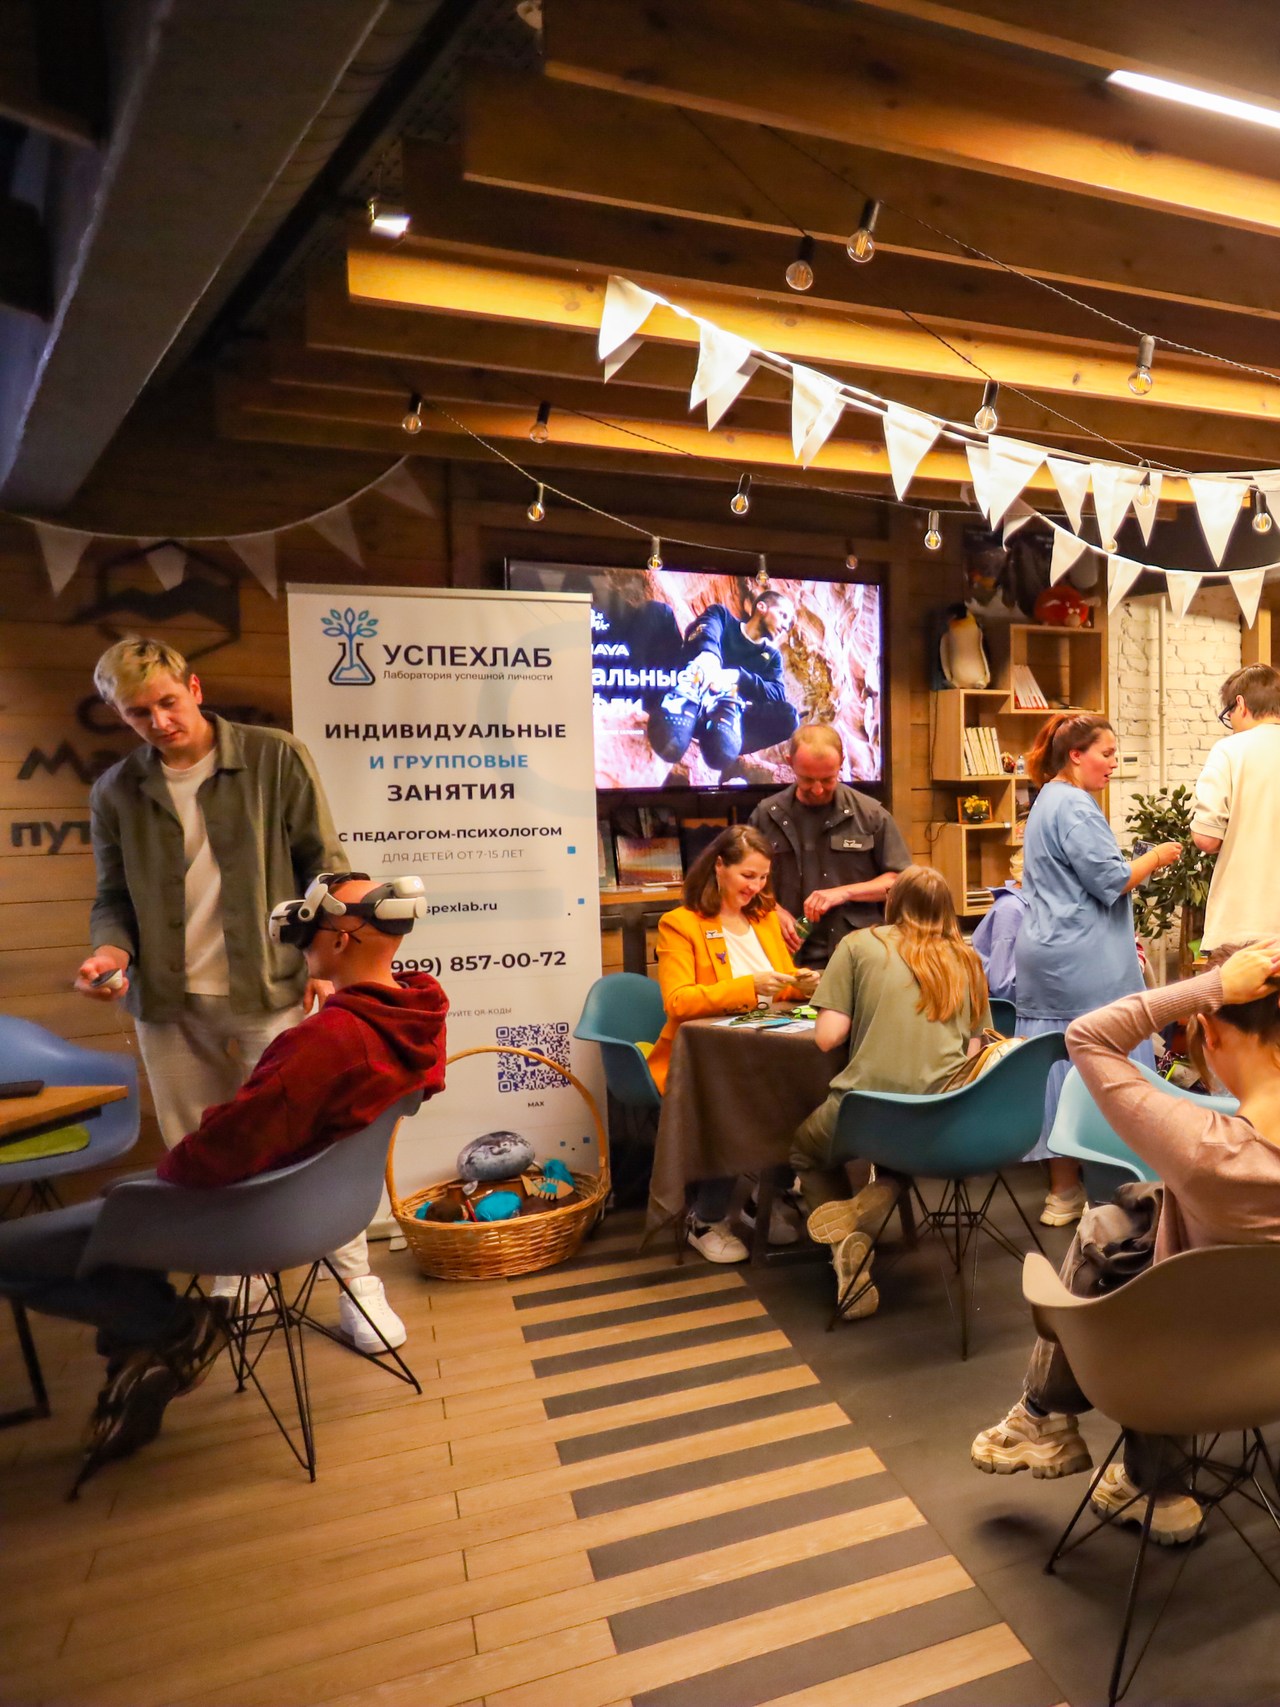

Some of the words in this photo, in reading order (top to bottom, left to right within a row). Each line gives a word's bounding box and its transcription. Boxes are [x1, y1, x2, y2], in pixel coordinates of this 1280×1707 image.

[383, 644, 552, 667] УСПЕХЛАБ
[383, 670, 452, 681] Лаборатория
[454, 671, 505, 682] успешной
[508, 673, 553, 681] личности
[325, 723, 566, 741] ИНДИВИДУАЛЬНЫЕ
[369, 756, 384, 769] И
[394, 755, 529, 769] ГРУППОВЫЕ
[387, 783, 515, 801] ЗАНЯТИЯ
[338, 832, 349, 842] С
[353, 826, 562, 843] ПЕДАГОГОМ-ПСИХОЛОГОМ
[382, 852, 409, 863] ДЛЯ
[412, 849, 454, 863] ДЕТЕЙ
[459, 850, 474, 860] ОТ
[476, 850, 499, 860] 7-15
[501, 849, 524, 859] ЛЕТ
[450, 951, 567, 973] 857-00-72
[475, 1008, 512, 1017] QR-КОДЫ
